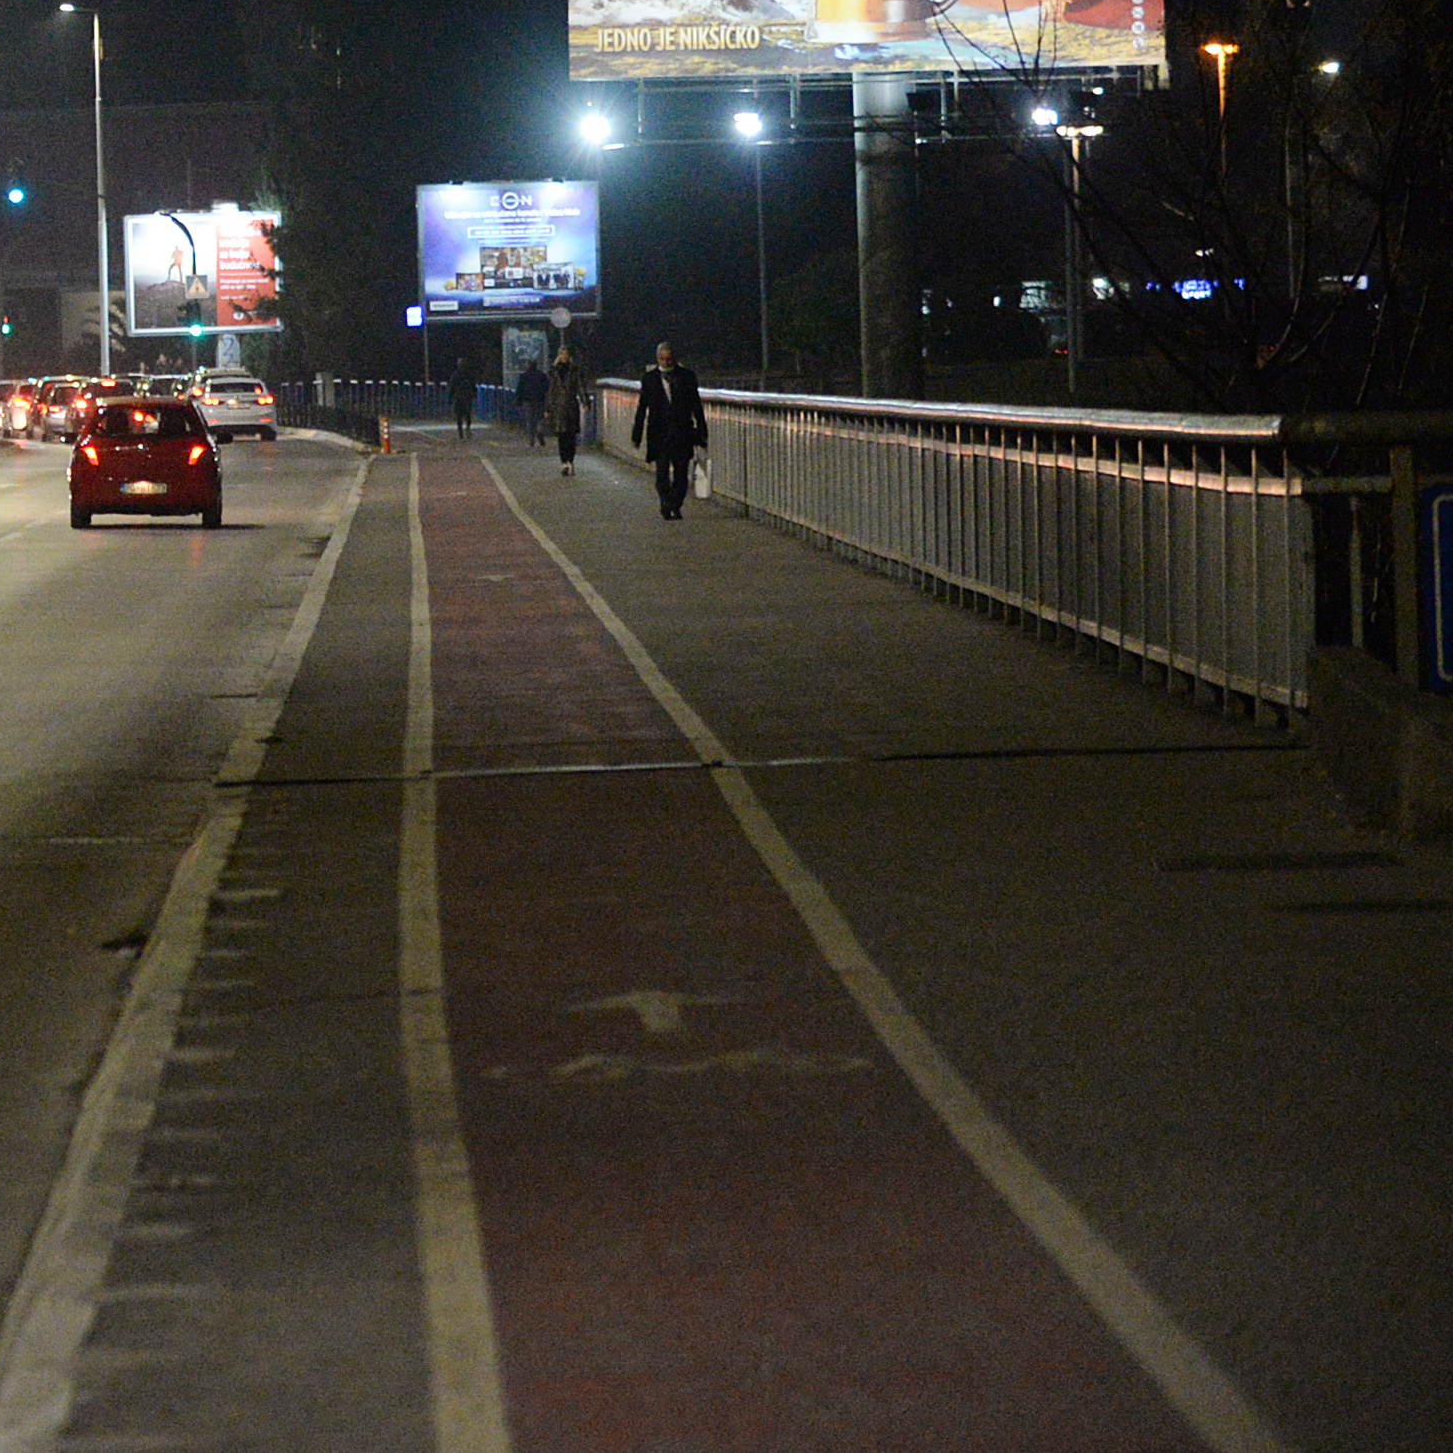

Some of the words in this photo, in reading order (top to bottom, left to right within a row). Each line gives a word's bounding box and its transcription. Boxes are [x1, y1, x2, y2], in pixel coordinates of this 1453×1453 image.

[593, 27, 652, 53] JEDNO
[655, 26, 677, 51] JE
[679, 21, 761, 51] NIKŠIĆKO
